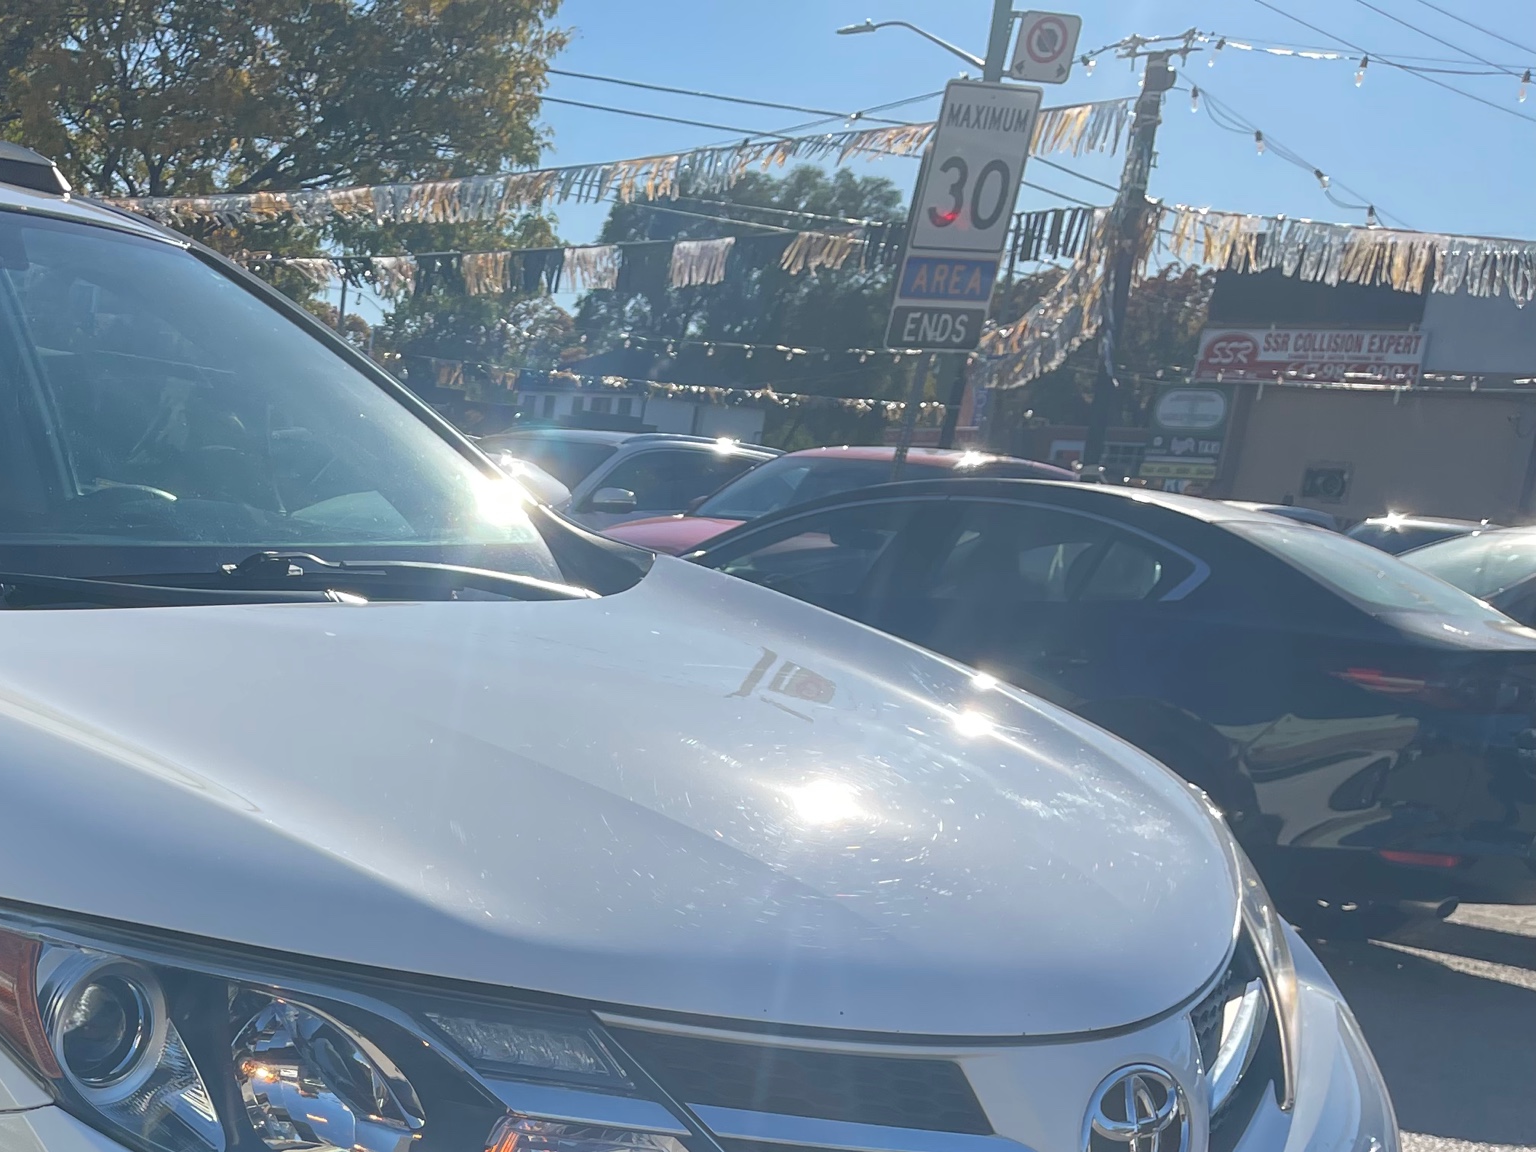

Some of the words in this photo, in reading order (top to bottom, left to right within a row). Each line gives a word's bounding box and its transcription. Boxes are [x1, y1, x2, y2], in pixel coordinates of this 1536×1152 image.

[945, 103, 1030, 133] MAXIMUM
[927, 155, 1011, 231] 30
[910, 264, 982, 296] AREA
[902, 311, 969, 344] ENDS
[1208, 341, 1254, 364] SSR
[1263, 333, 1290, 352] SSR
[1293, 333, 1363, 353] COLLISION
[1367, 333, 1422, 355] EXPERT
